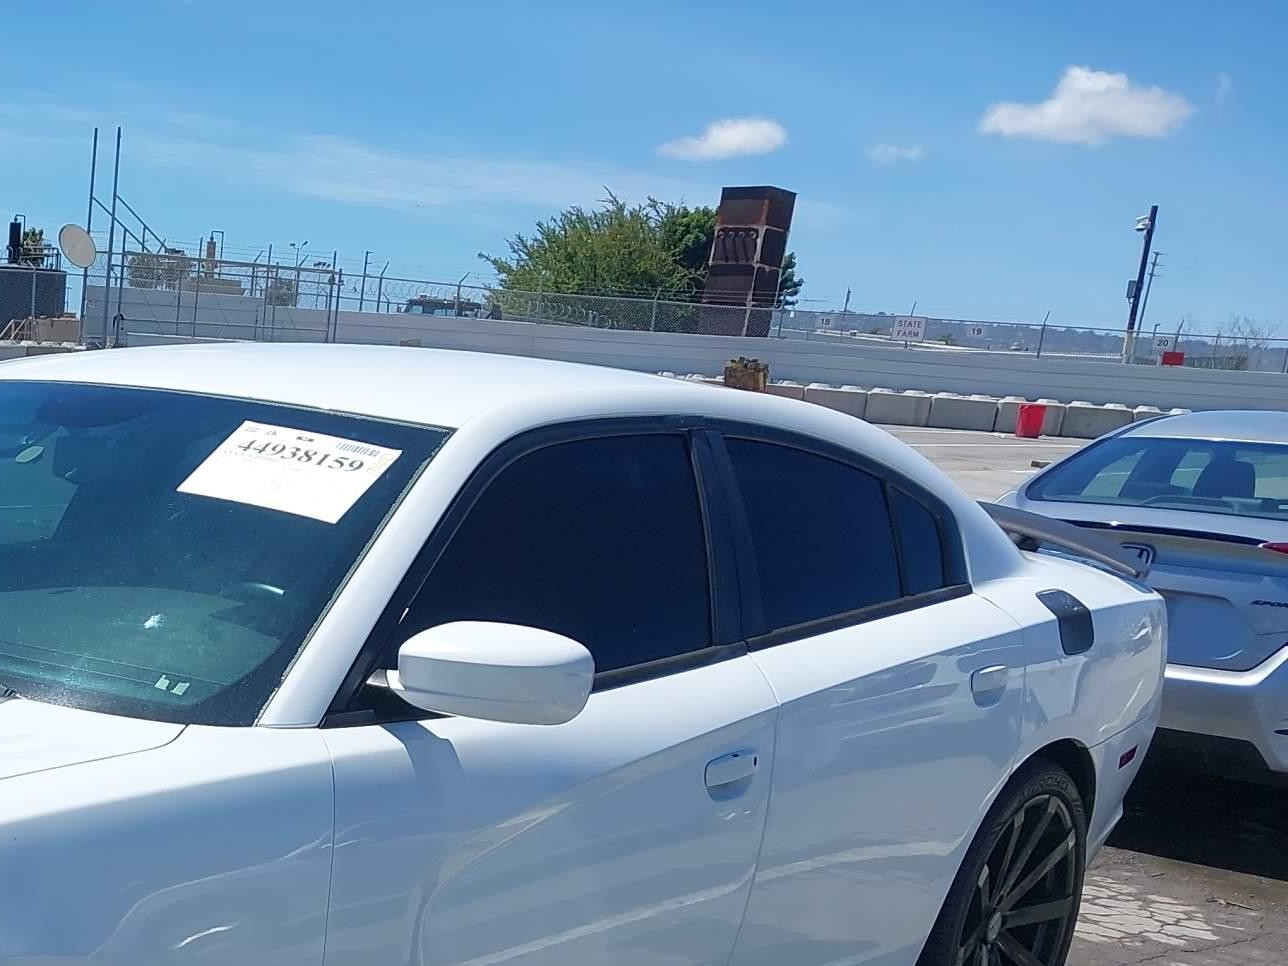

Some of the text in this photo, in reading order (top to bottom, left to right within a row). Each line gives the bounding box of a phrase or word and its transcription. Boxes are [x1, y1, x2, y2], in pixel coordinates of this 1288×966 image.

[896, 319, 922, 329] STATE
[896, 329, 920, 338] FARM
[971, 327, 982, 336] 19
[1157, 339, 1169, 347] 20
[237, 439, 365, 472] 44938159
